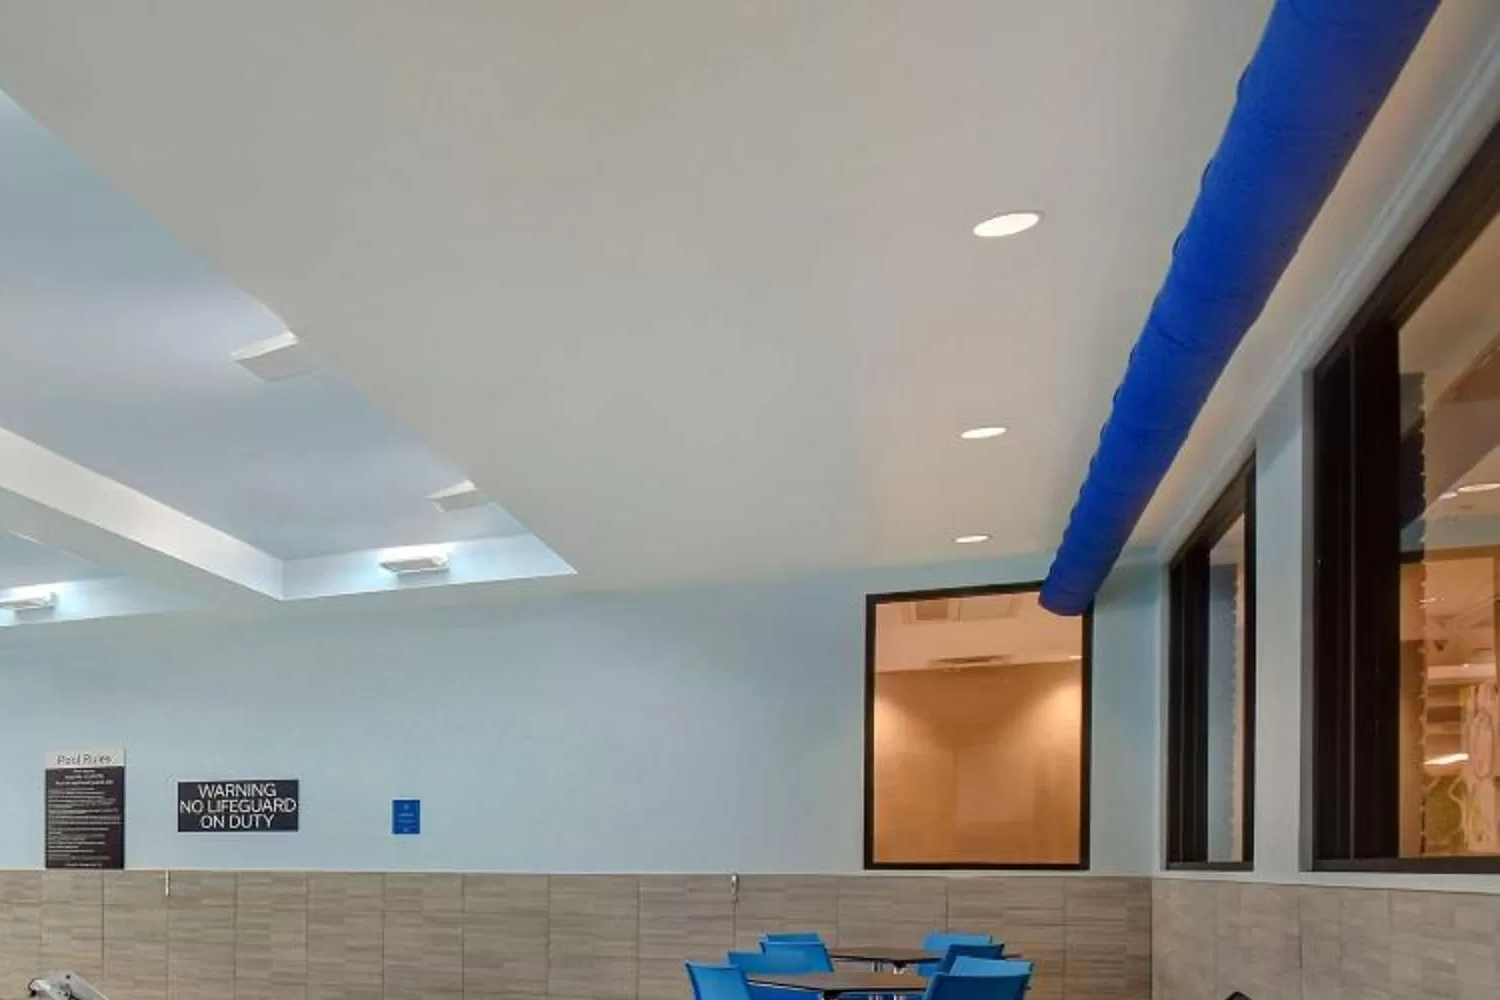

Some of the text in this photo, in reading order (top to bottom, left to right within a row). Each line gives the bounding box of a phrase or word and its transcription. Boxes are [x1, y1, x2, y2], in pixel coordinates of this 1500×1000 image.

[197, 783, 277, 799] WARNING
[180, 797, 297, 813] NO LIFEGUARD
[200, 813, 275, 829] ON DUTY
